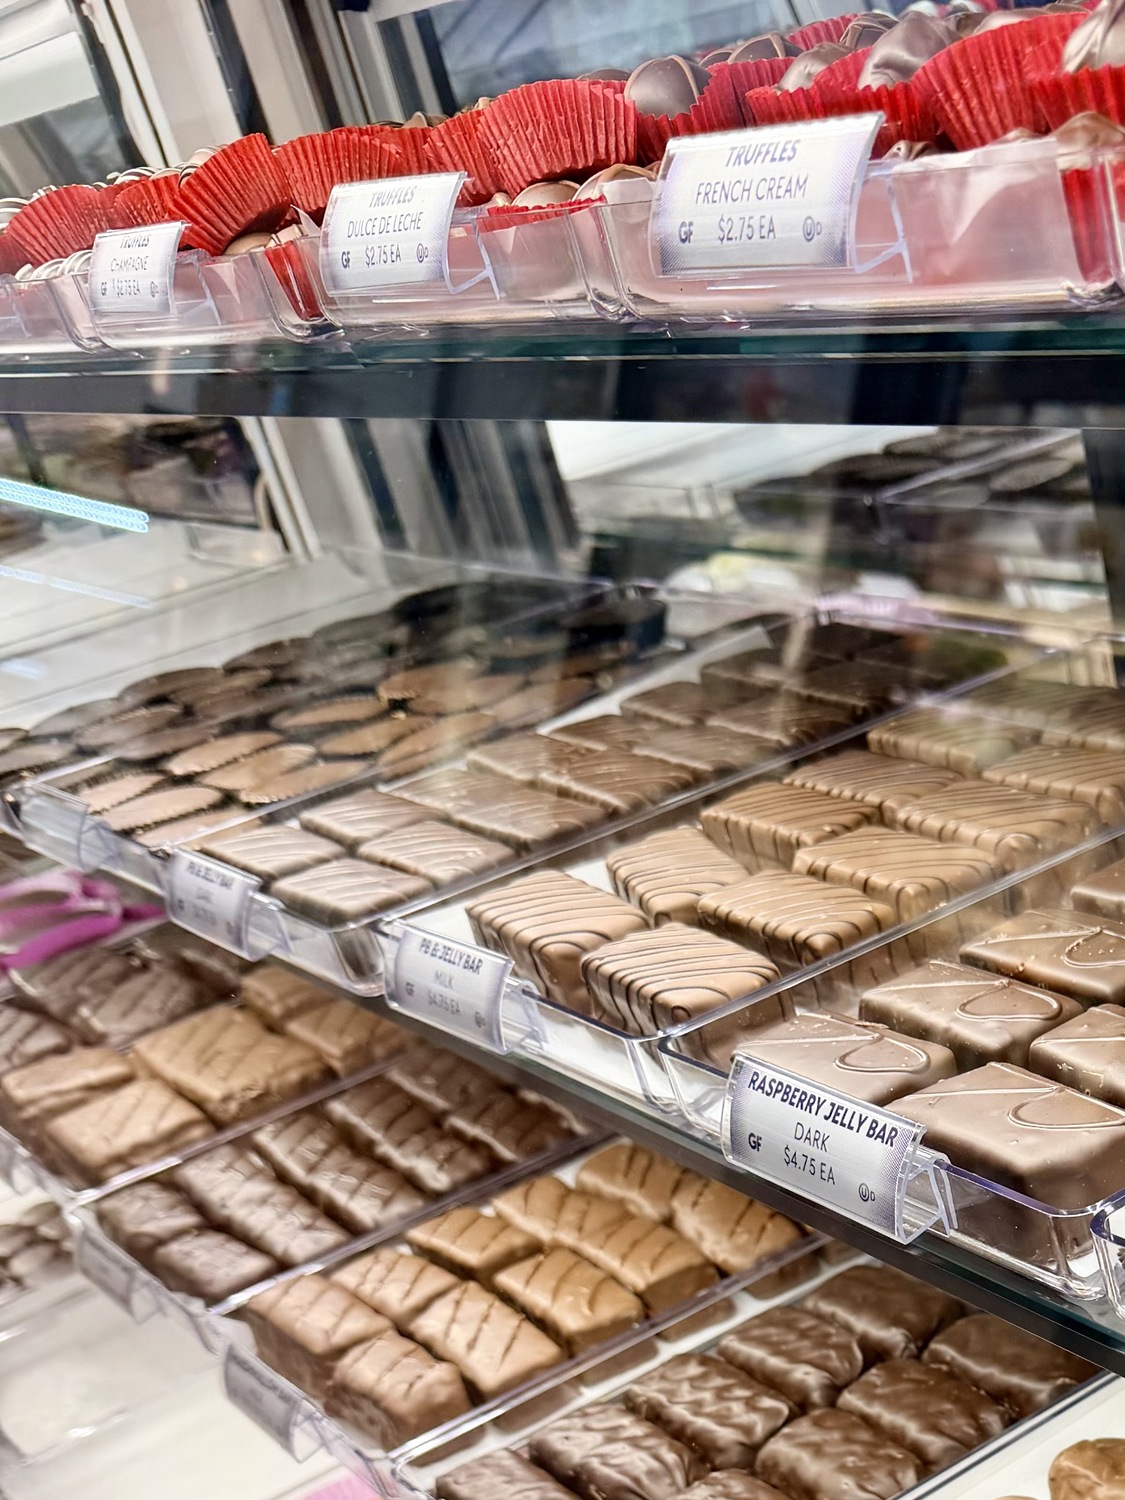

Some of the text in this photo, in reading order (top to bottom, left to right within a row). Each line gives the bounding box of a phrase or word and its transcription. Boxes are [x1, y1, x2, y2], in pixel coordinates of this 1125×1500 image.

[724, 139, 801, 167] TRUFFLES
[369, 185, 417, 208] TRUFFLES
[695, 174, 809, 205] FRENCH CREAM
[347, 211, 424, 238] DULCE DE LECHE
[678, 221, 694, 244] GF
[717, 214, 776, 245] $2.75 EA
[110, 256, 149, 272] CHAMPAGNE
[341, 250, 351, 269] GF
[365, 243, 402, 268] $2.75 EA
[438, 945, 465, 968] JELLY
[463, 956, 484, 975] BAR
[434, 970, 455, 990] MILK
[747, 1071, 899, 1148] RASPBERRY JELLY BAR
[748, 1132, 763, 1152] GF
[794, 1122, 831, 1153] DARK
[783, 1144, 836, 1186] $4.75 EA
